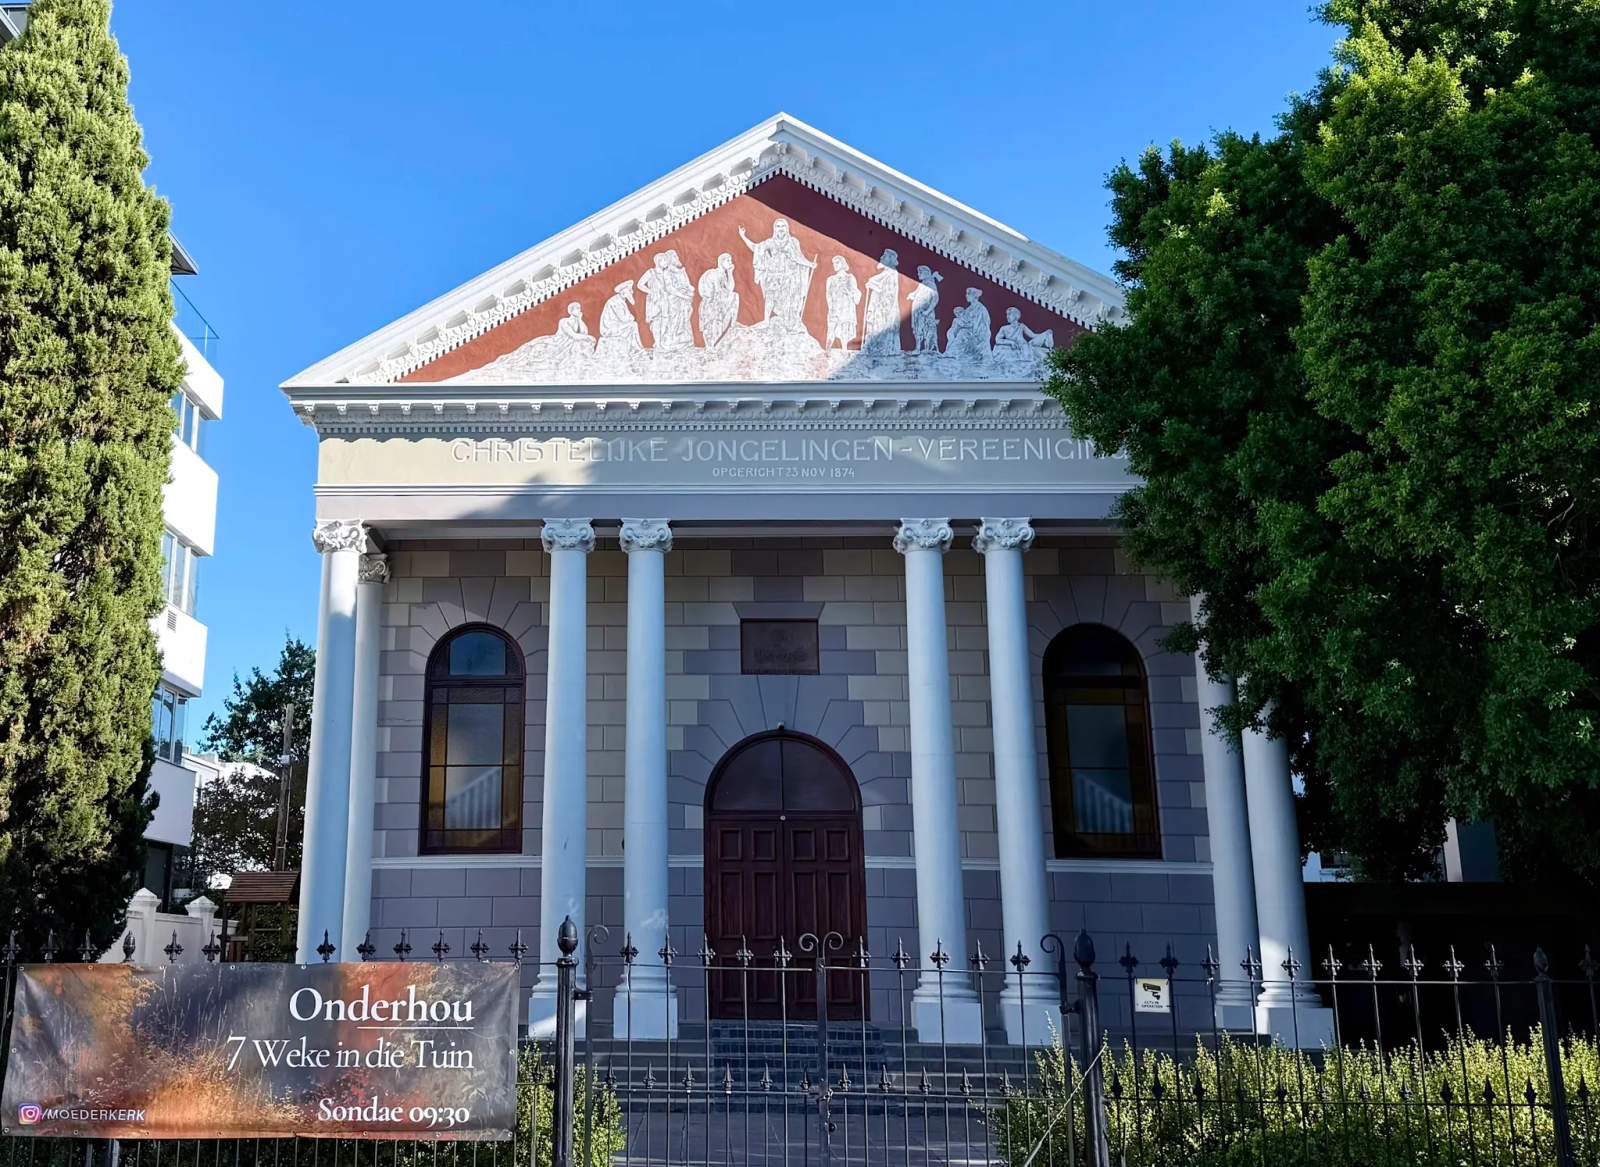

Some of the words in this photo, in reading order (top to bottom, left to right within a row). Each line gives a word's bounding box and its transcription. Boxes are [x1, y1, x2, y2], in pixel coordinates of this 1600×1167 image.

[451, 438, 668, 463] CHRISTELIJKE
[801, 467, 826, 478] NOV
[830, 467, 856, 478] 1874
[288, 983, 475, 1023] Onderhou
[226, 1034, 247, 1071] 7
[251, 1036, 331, 1069] Weke
[335, 1041, 361, 1069] in
[365, 1037, 405, 1069] die
[410, 1039, 475, 1070] Tuin
[317, 1096, 404, 1123] Sondae
[408, 1105, 471, 1128] 09:30
